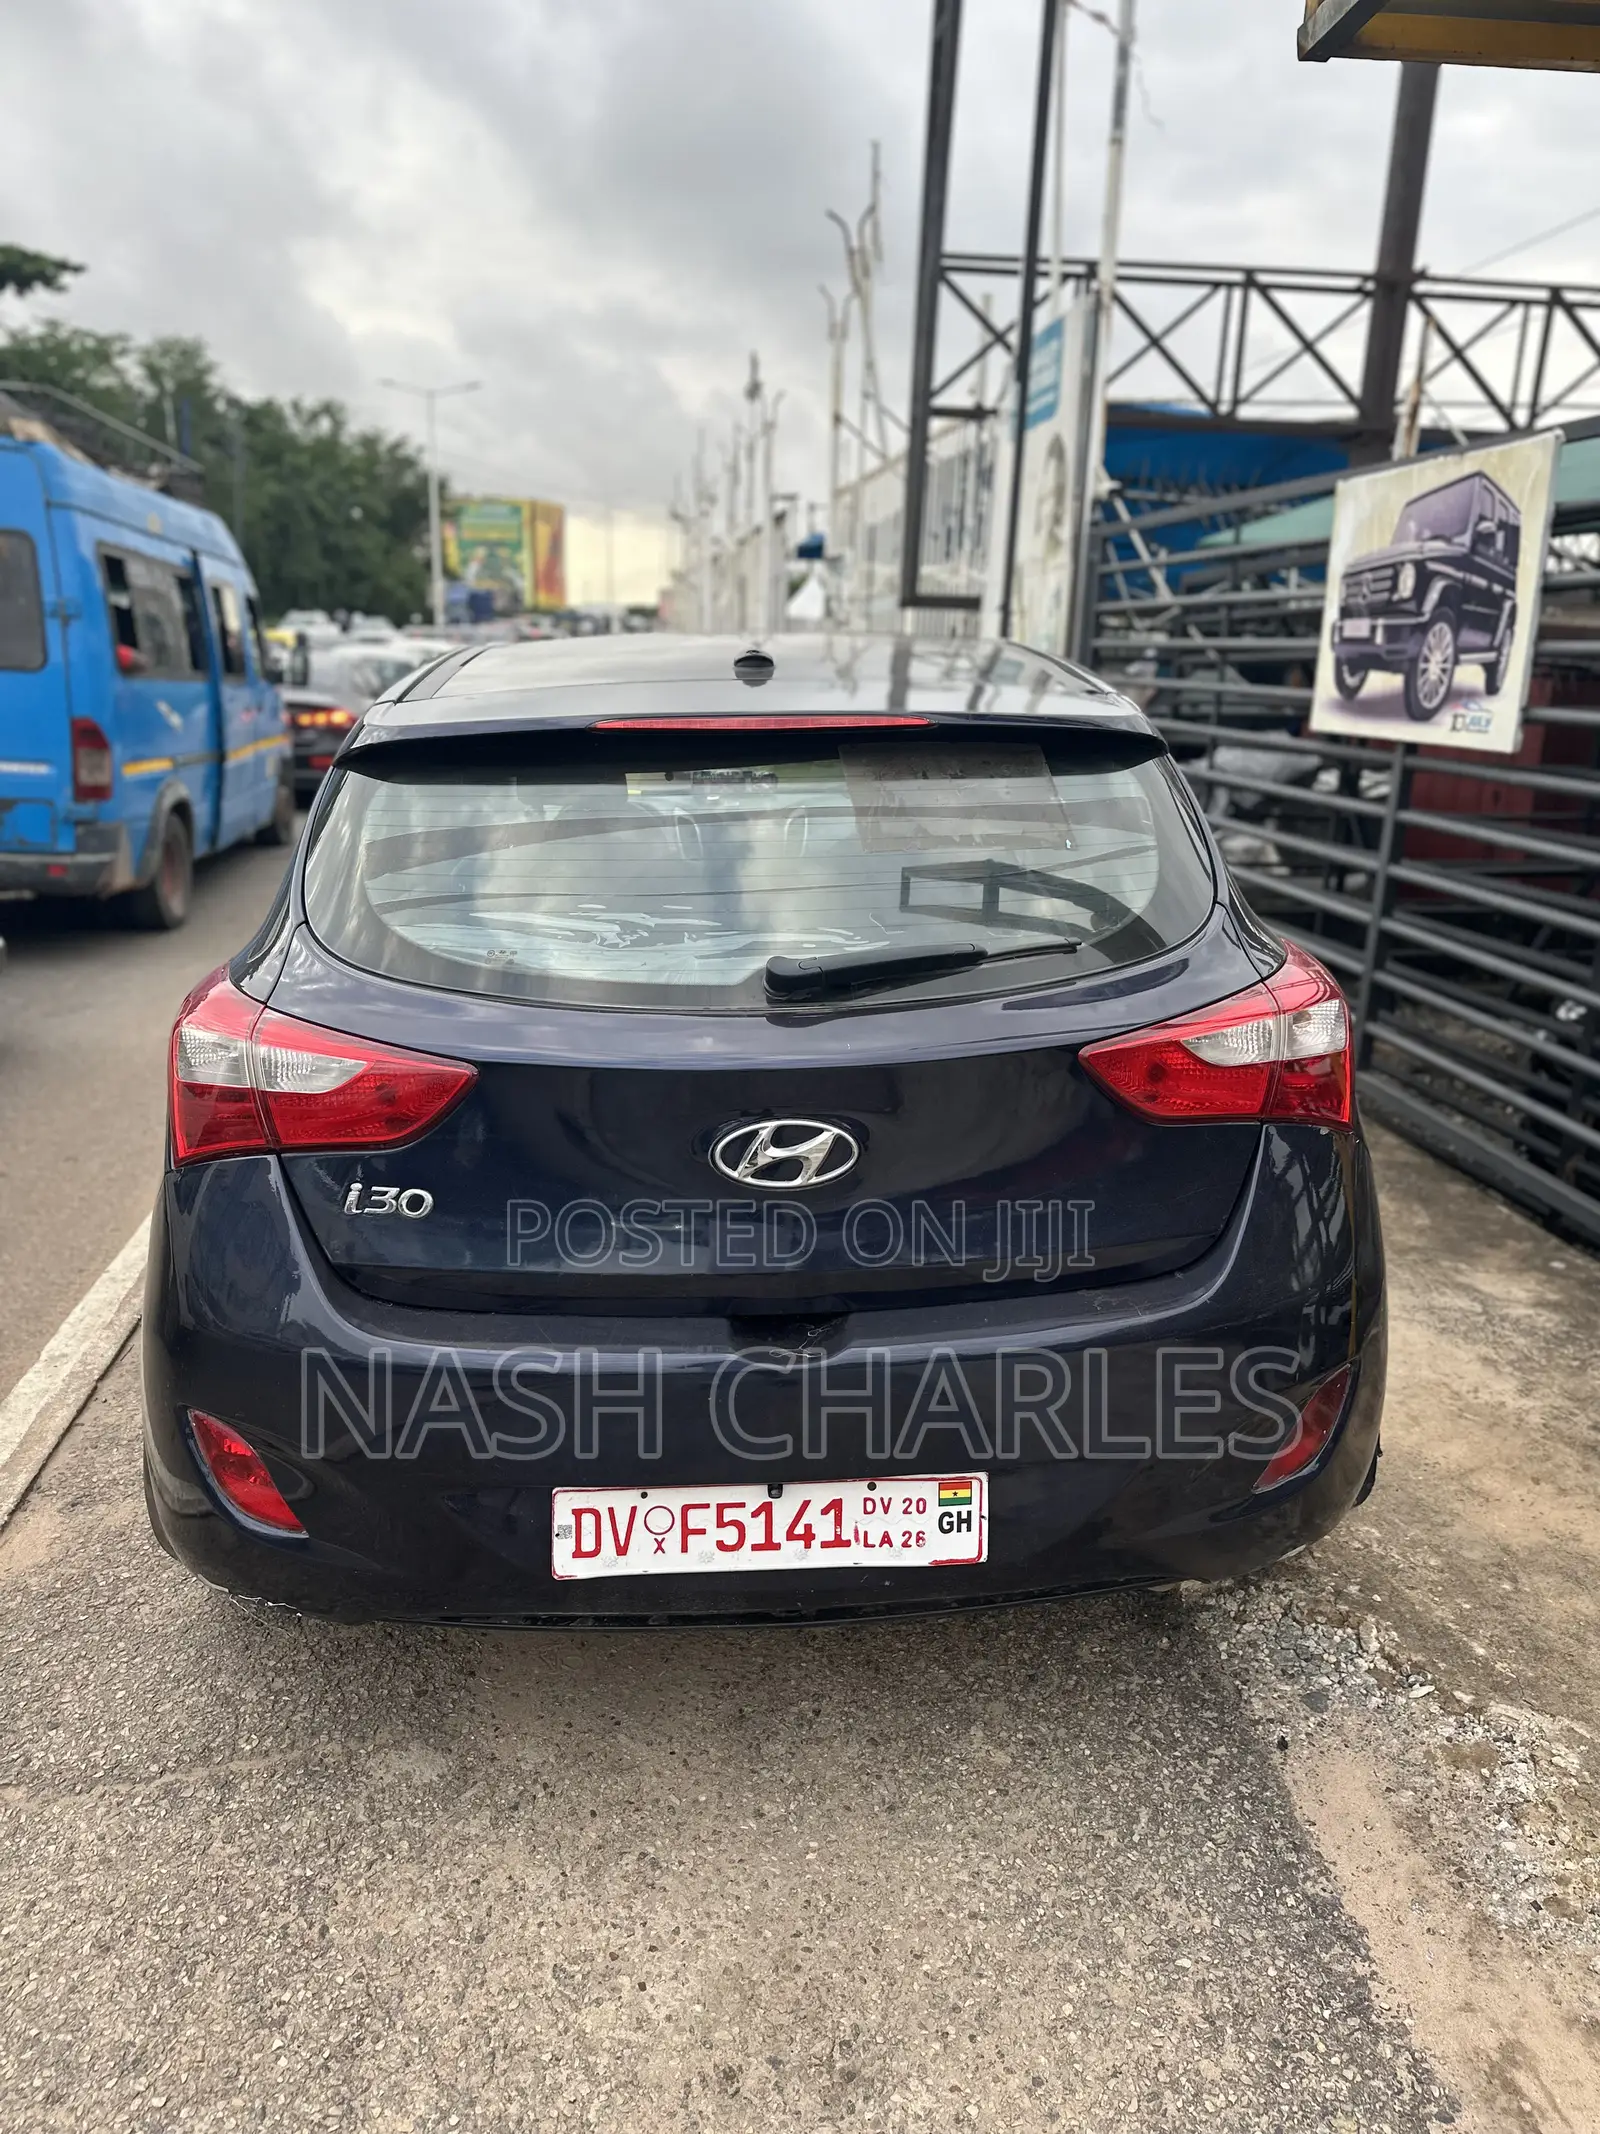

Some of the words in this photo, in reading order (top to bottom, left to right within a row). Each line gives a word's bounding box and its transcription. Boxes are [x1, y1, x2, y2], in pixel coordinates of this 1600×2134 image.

[344, 1182, 434, 1219] i30
[863, 1497, 892, 1515] DV
[902, 1497, 926, 1515] 20
[572, 1506, 637, 1558] DV
[681, 1498, 851, 1553] F5141
[938, 1510, 972, 1534] GH
[863, 1531, 893, 1548] LA
